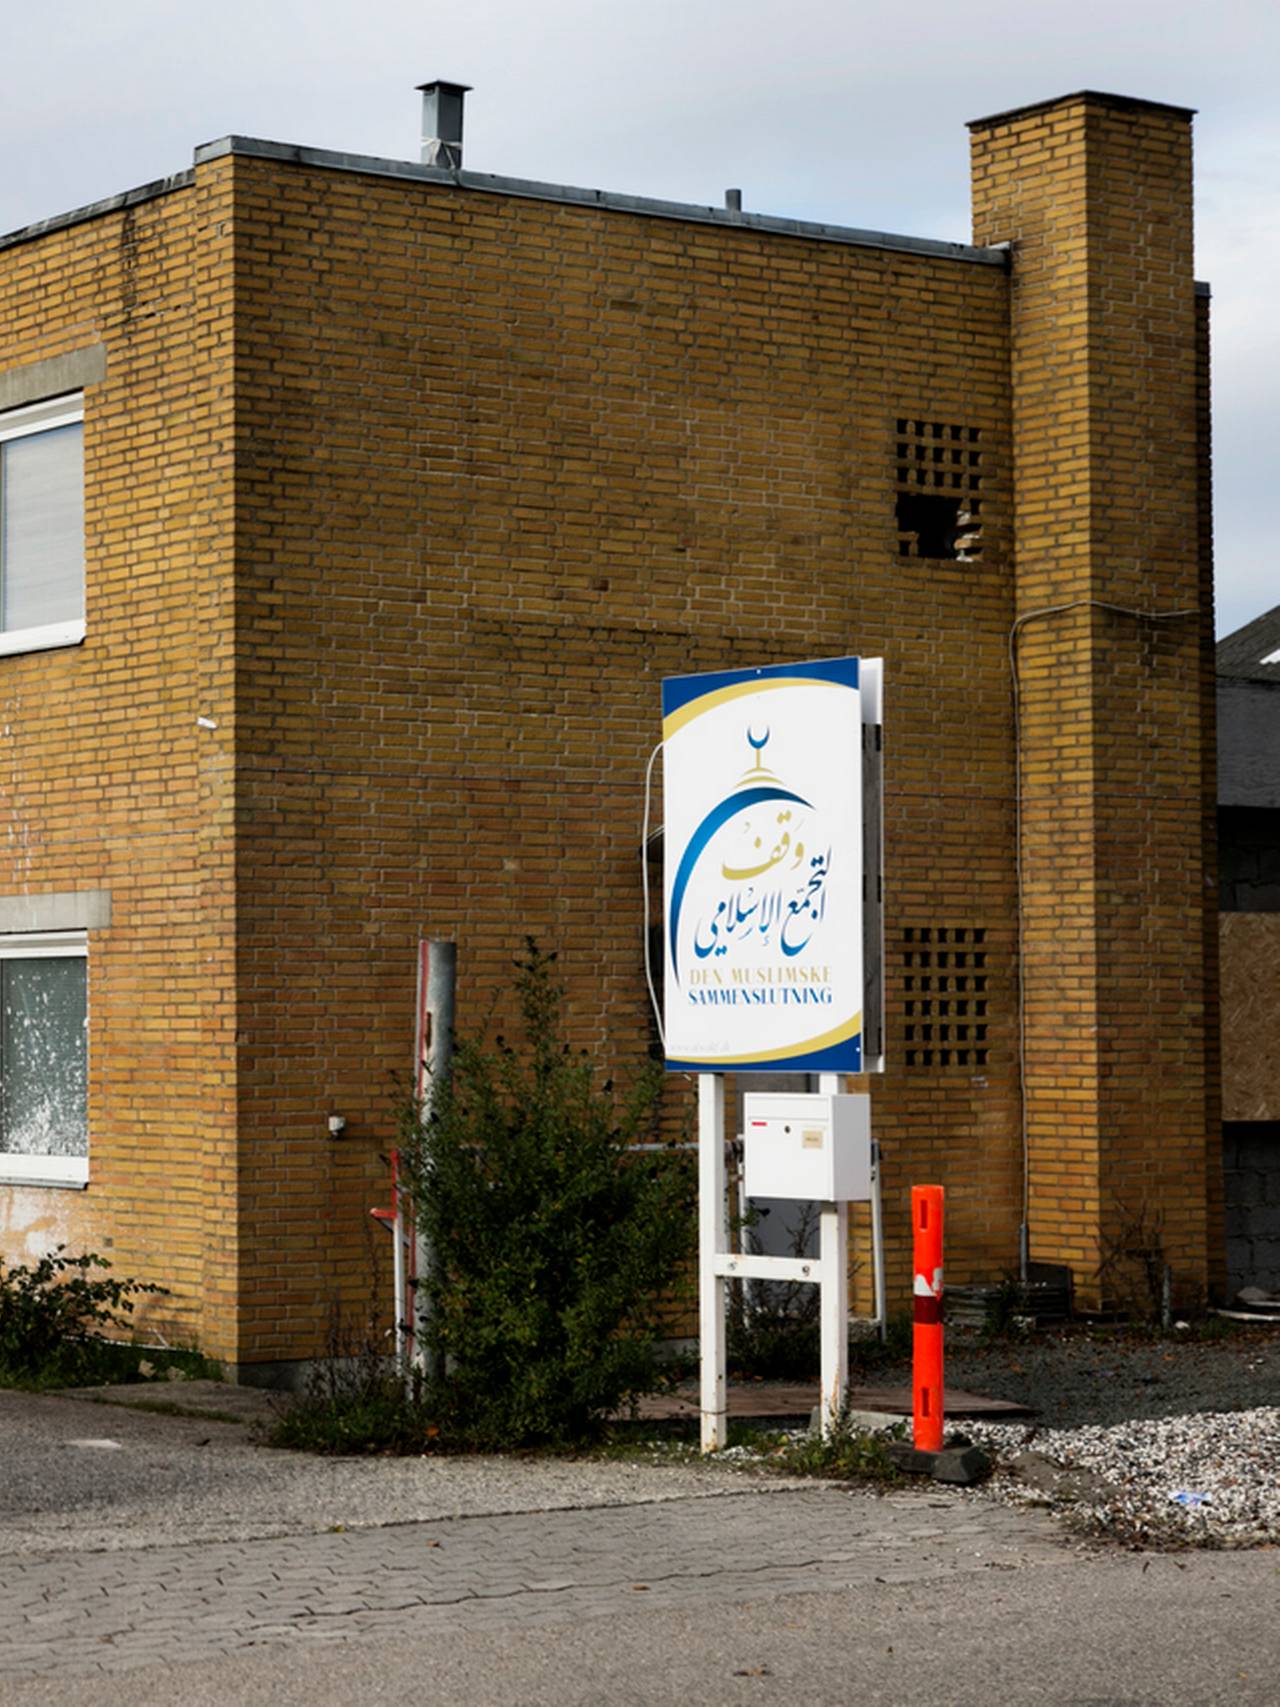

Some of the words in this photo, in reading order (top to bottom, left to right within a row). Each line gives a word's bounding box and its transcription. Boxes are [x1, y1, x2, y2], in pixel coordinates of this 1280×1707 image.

[689, 968, 723, 985] DEN
[732, 966, 831, 985] MUSLIMSKE
[688, 987, 832, 1005] SAMMENSLUTNING
